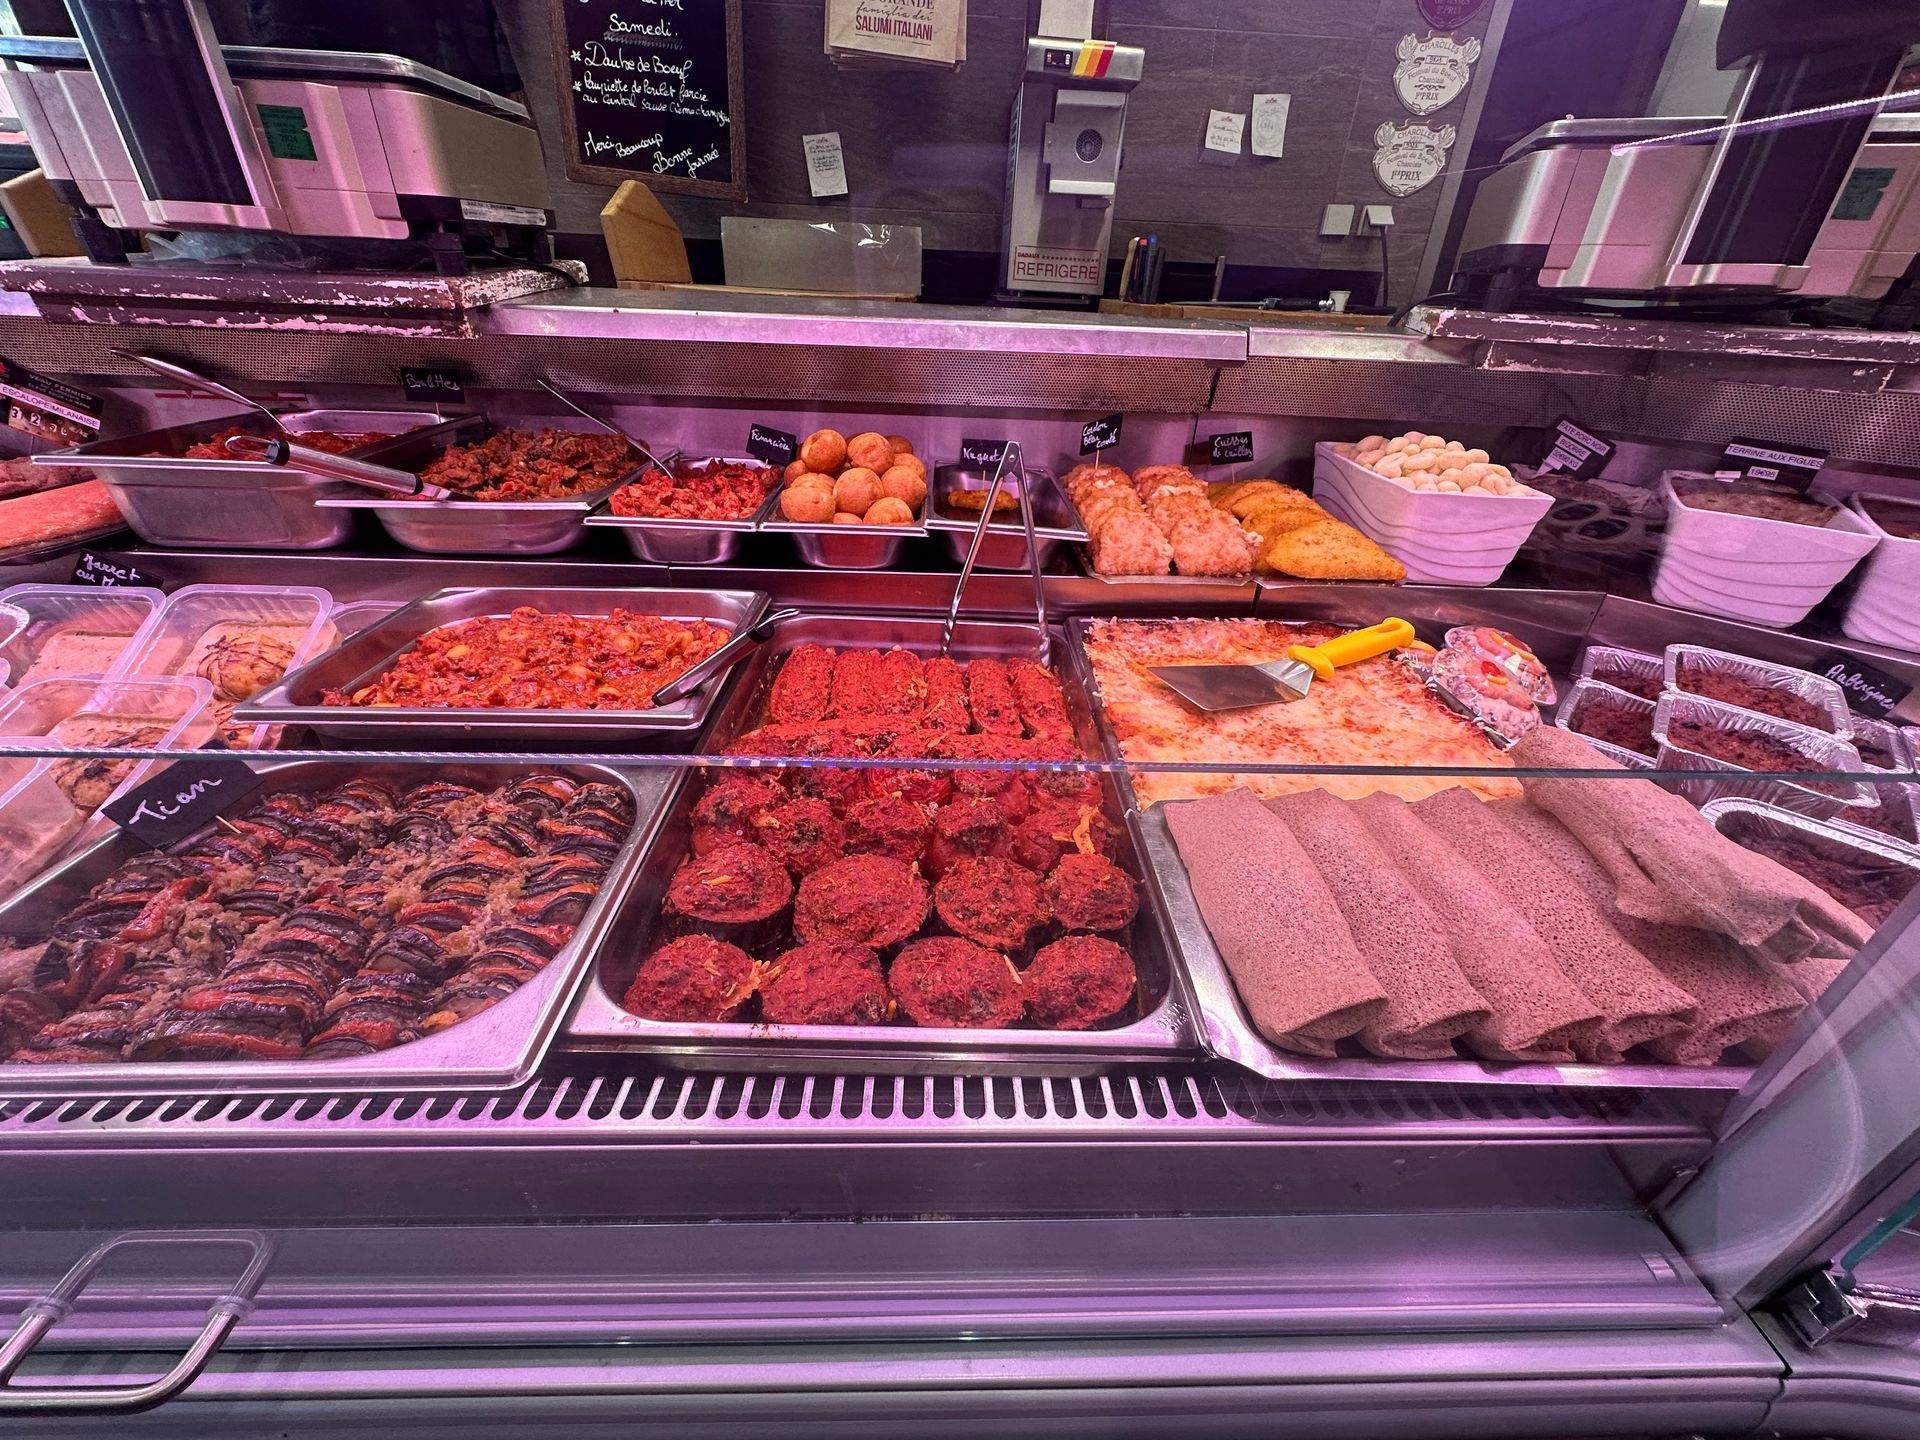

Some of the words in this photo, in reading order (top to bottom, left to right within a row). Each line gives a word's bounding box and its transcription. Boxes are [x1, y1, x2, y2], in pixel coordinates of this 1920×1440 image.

[856, 1, 909, 20] famiglia
[912, 9, 934, 21] dei
[855, 14, 892, 35] SALUMI
[893, 19, 933, 41] ITALIANI
[1419, 40, 1460, 55] CHAROLLES
[637, 56, 651, 73] de
[584, 131, 615, 157] Merci
[1397, 128, 1437, 141] CHAROLLES
[652, 147, 694, 174] Bonne
[1016, 261, 1098, 280] REFRIGERE
[2, 386, 50, 409] ESCALOPE
[50, 406, 99, 427] MILANAISE
[1727, 445, 1766, 458] TERRINE
[1767, 453, 1788, 462] AUX
[1788, 456, 1825, 468] FIGUES
[128, 779, 223, 825] Tian
